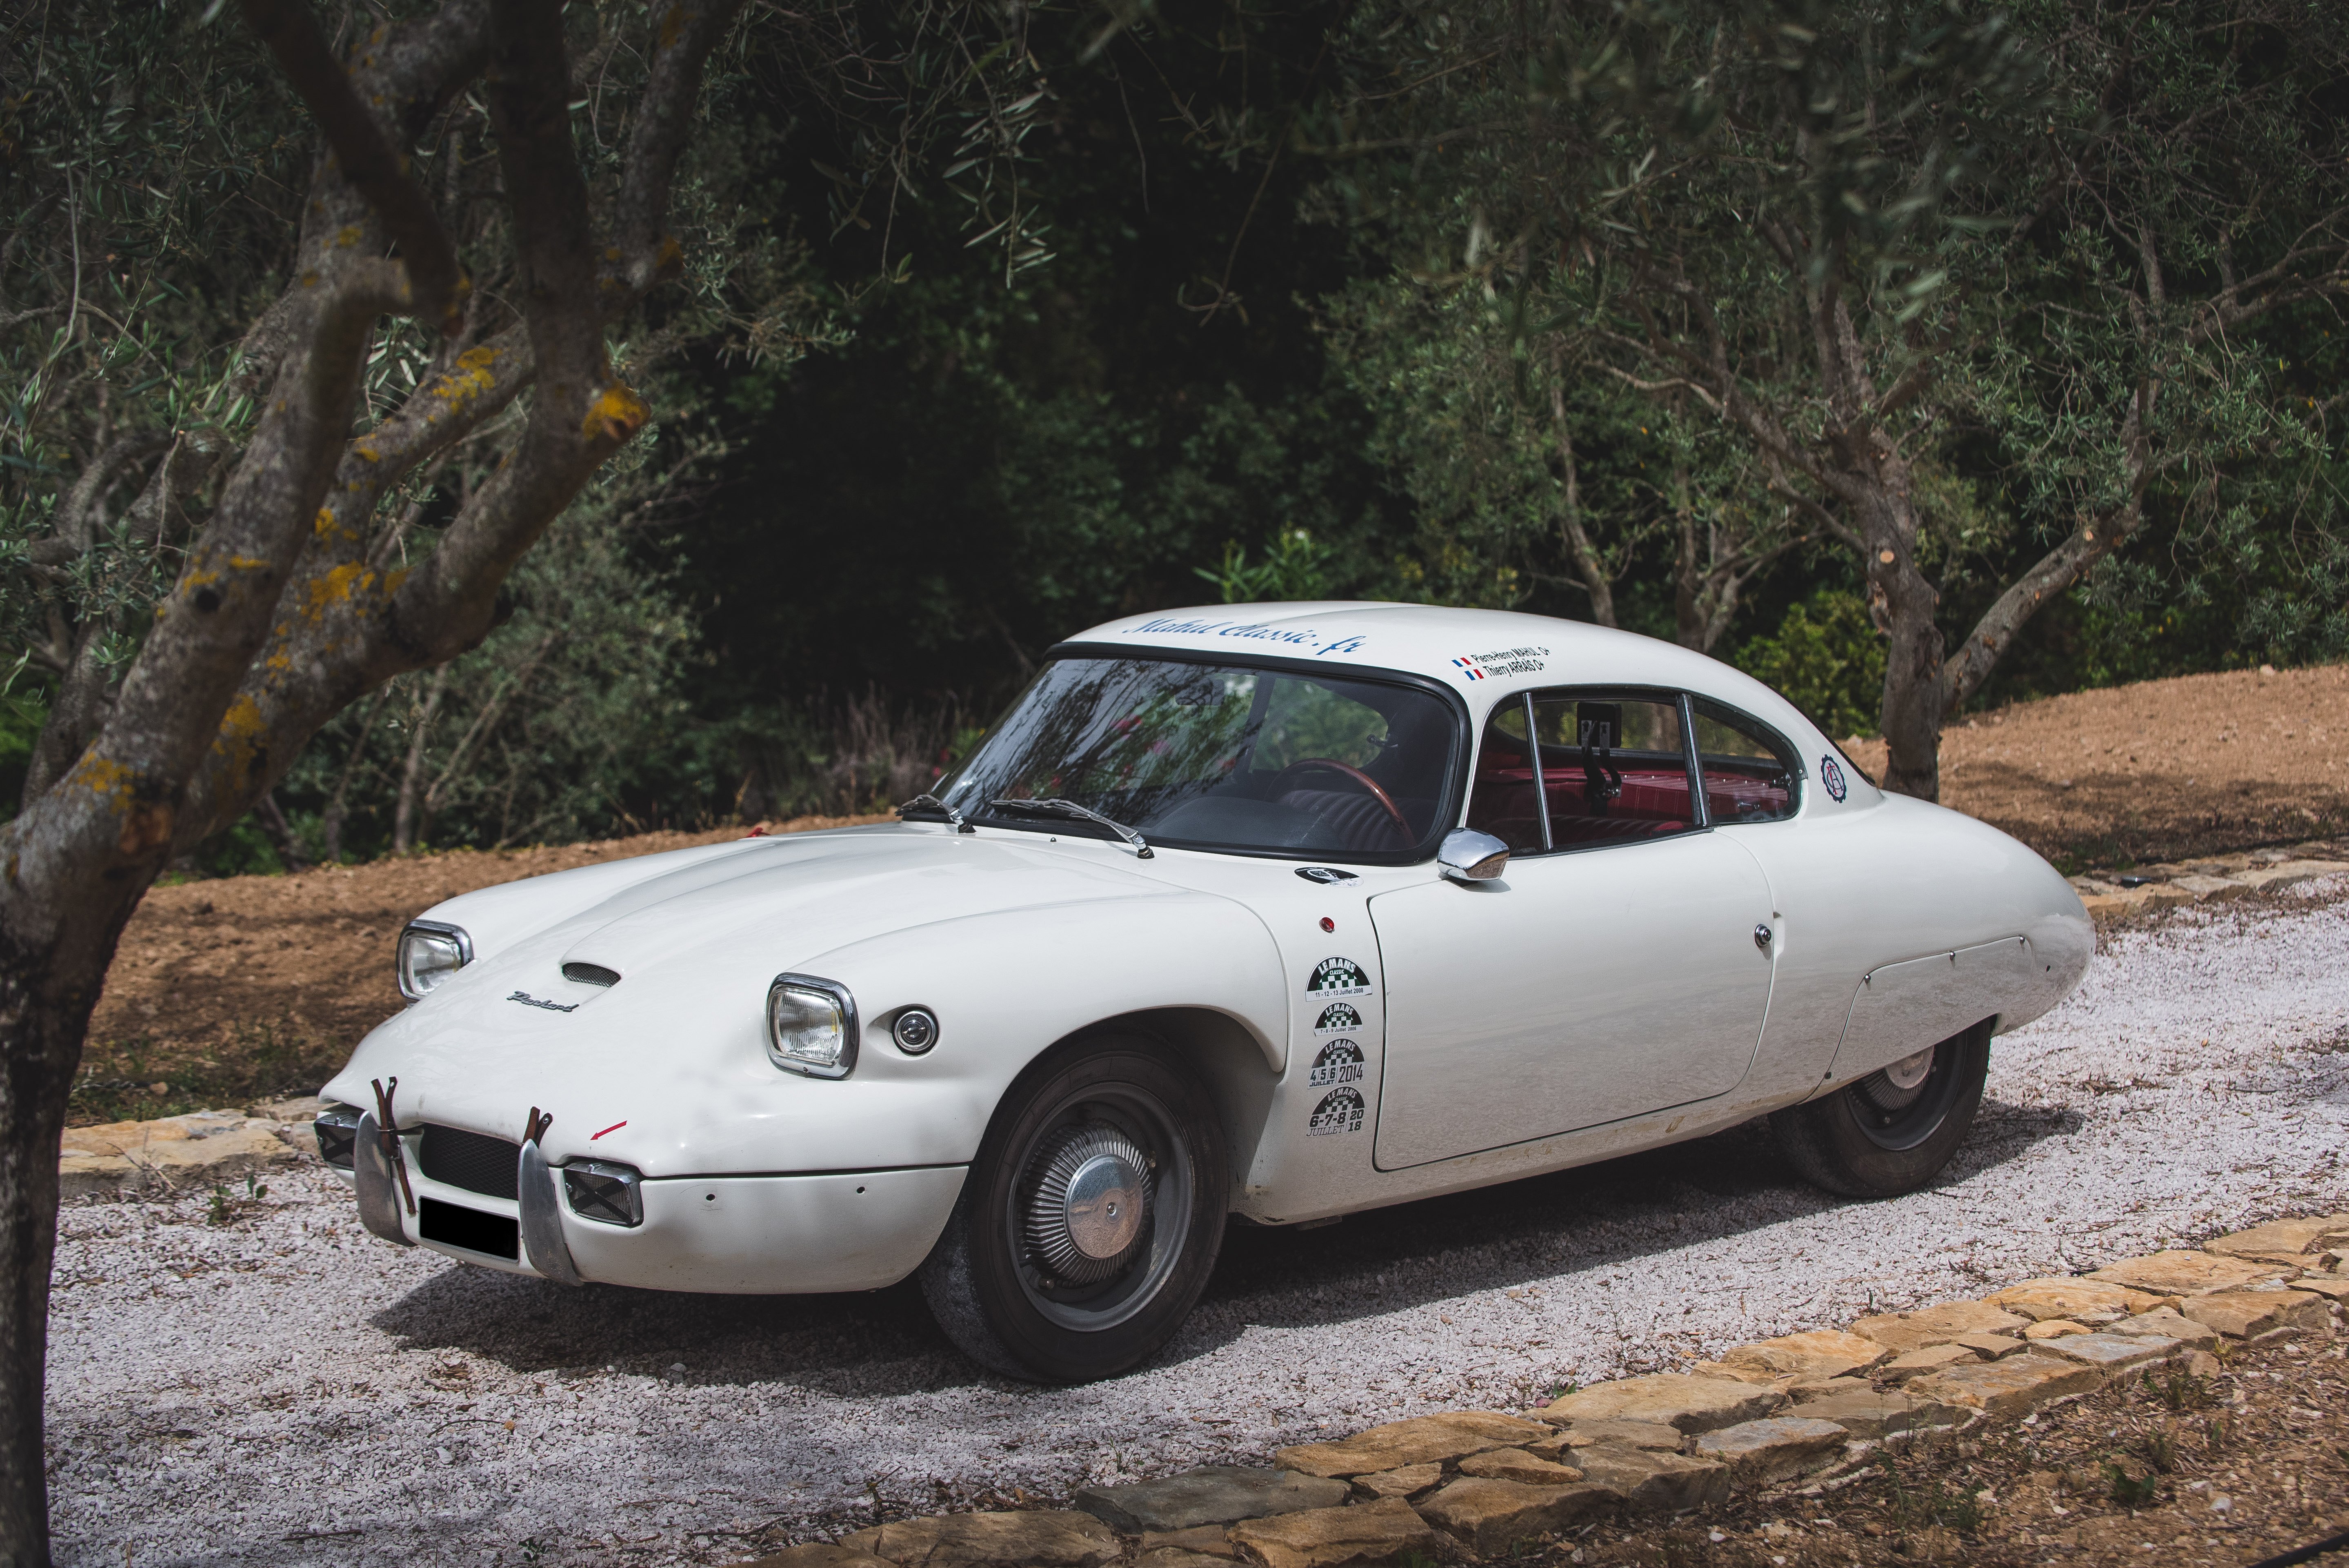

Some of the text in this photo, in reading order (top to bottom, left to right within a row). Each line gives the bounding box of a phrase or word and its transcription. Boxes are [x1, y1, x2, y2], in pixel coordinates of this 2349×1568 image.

[1122, 618, 1234, 633] Mahul
[1471, 651, 1517, 664] Pierre-Henry
[1511, 647, 1540, 658] MAHUL
[1482, 665, 1511, 677] Thierry
[1318, 958, 1356, 975] LE MANS
[1325, 1004, 1353, 1017] LE MANS
[1325, 1039, 1355, 1054] LE MANS
[1338, 1064, 1363, 1083] 2014
[1328, 1088, 1357, 1102] LE MANS
[1309, 1109, 1364, 1128] 6-7-8 20
[1306, 1121, 1362, 1137] JUILLET 18
